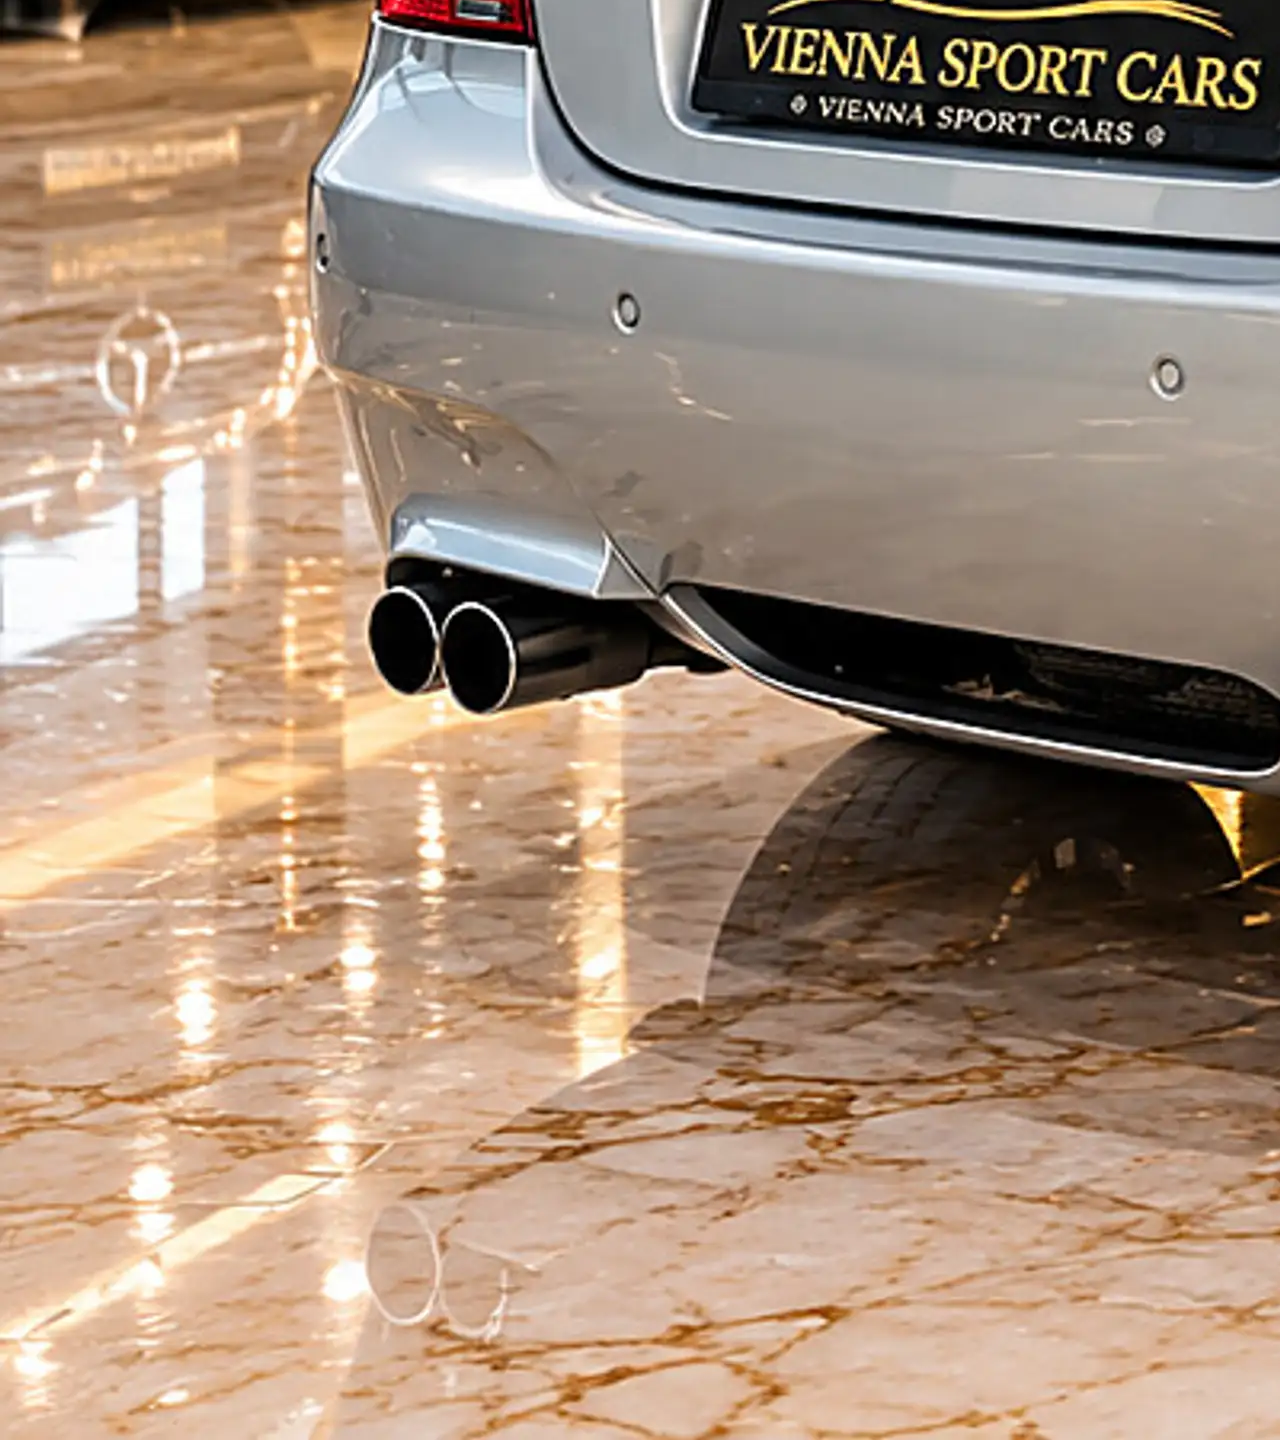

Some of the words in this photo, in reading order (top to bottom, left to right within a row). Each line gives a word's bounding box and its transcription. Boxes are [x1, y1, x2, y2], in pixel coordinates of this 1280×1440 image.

[740, 22, 925, 85] VIENNA
[936, 37, 1108, 97] SPORT
[1115, 50, 1263, 111] CARS
[818, 95, 926, 127] VIENNA
[936, 105, 1042, 137] SPORT
[1048, 115, 1135, 146] CARS
